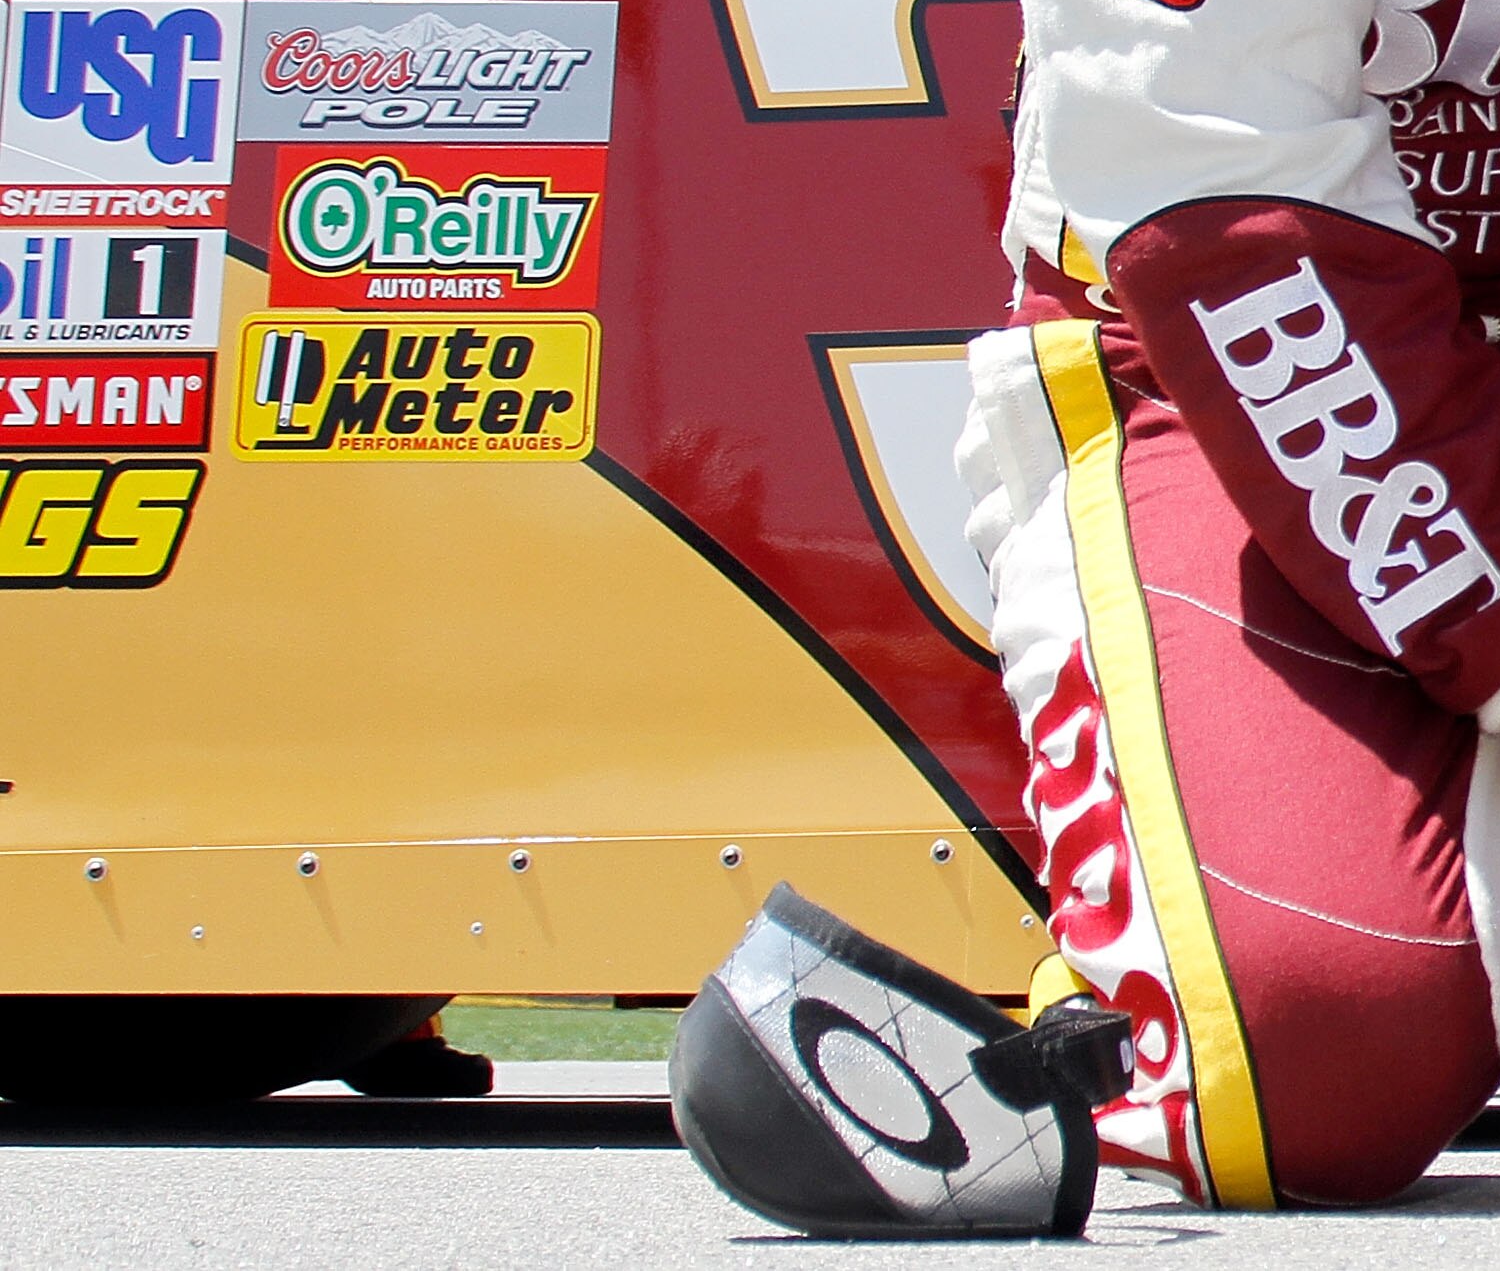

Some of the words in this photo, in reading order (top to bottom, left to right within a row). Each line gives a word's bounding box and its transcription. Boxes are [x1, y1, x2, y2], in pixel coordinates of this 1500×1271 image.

[20, 7, 223, 165] USG
[261, 28, 418, 94] Coors
[415, 49, 590, 92] LIGHT
[300, 97, 541, 129] POLE
[1, 189, 214, 218] SHEETROCK
[299, 174, 592, 271] O'Reilly
[132, 244, 164, 315] 1
[366, 278, 428, 300] AUTO
[430, 278, 501, 300] PARTS
[24, 324, 39, 341] &
[47, 324, 192, 341] LUBRICANTS
[337, 328, 534, 381] Auto
[0, 376, 185, 425] SMAN
[323, 381, 574, 435] Meter
[338, 437, 479, 451] PERFORMANCE
[485, 437, 564, 451] GAUGES
[0, 459, 207, 590] GS
